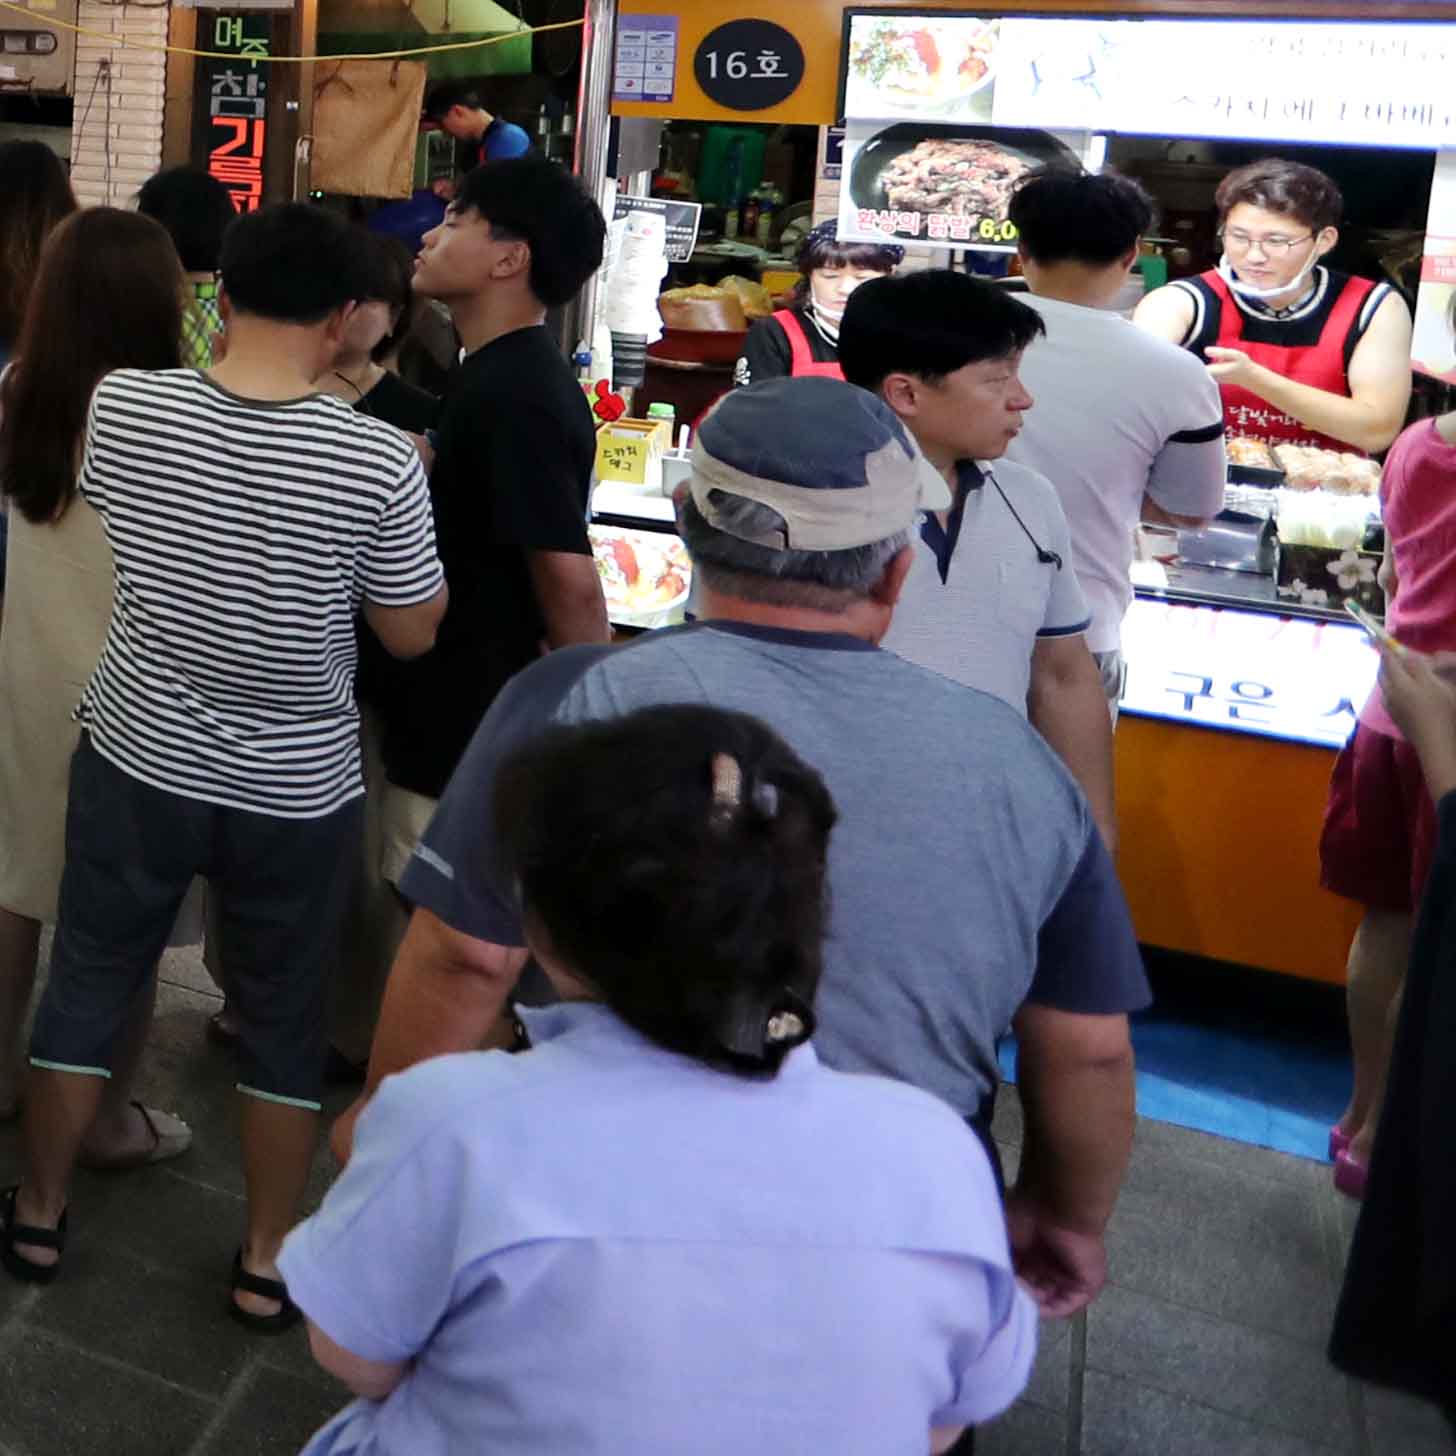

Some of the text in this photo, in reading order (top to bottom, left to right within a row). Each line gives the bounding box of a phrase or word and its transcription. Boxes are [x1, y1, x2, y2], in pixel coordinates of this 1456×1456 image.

[704, 49, 789, 80] 16호
[855, 208, 921, 236] 환상의
[1165, 670, 1278, 725] 구은
